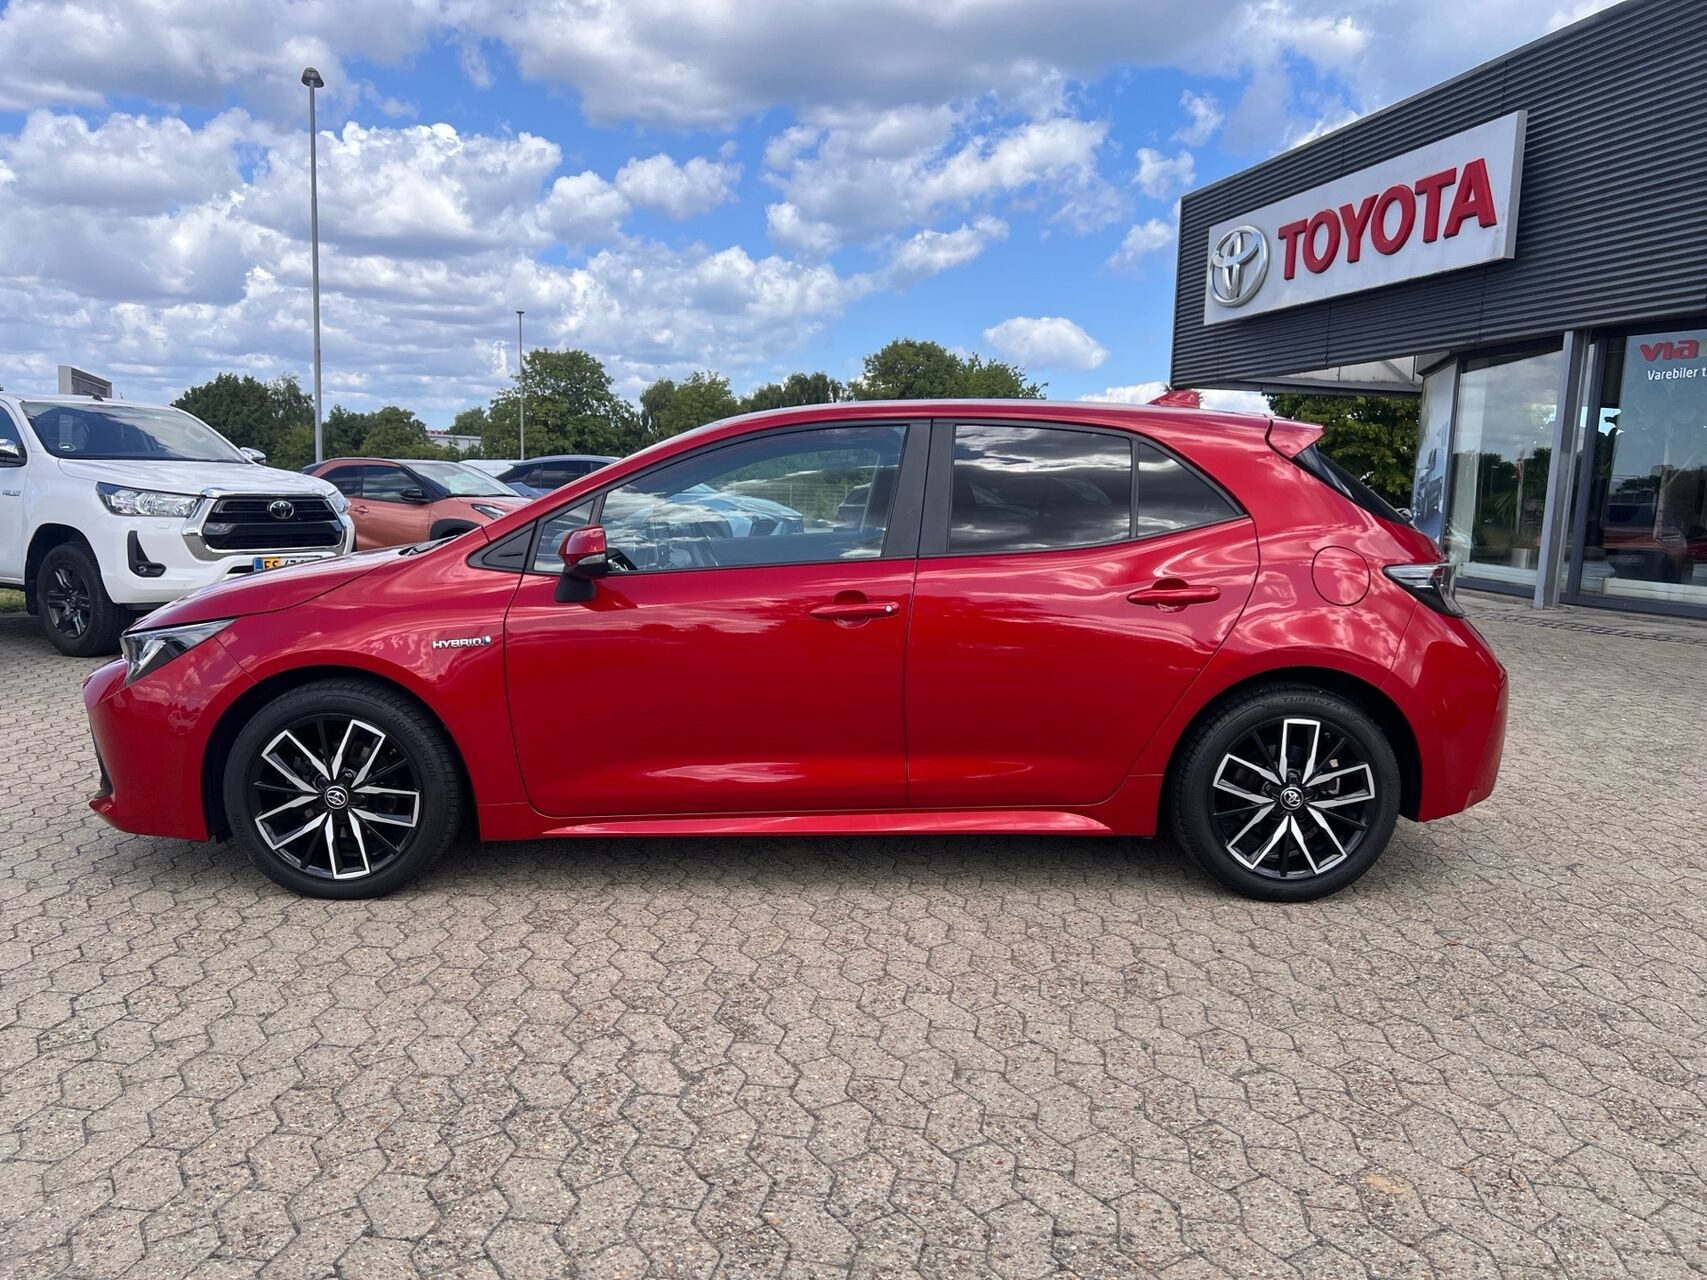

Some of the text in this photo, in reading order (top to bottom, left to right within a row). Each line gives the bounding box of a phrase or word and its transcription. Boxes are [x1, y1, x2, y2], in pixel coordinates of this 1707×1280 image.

[1278, 158, 1497, 280] TOYOTA
[1647, 367, 1698, 380] Varebiler
[432, 638, 481, 648] HYBRID
[1281, 696, 1341, 710] TURANZA
